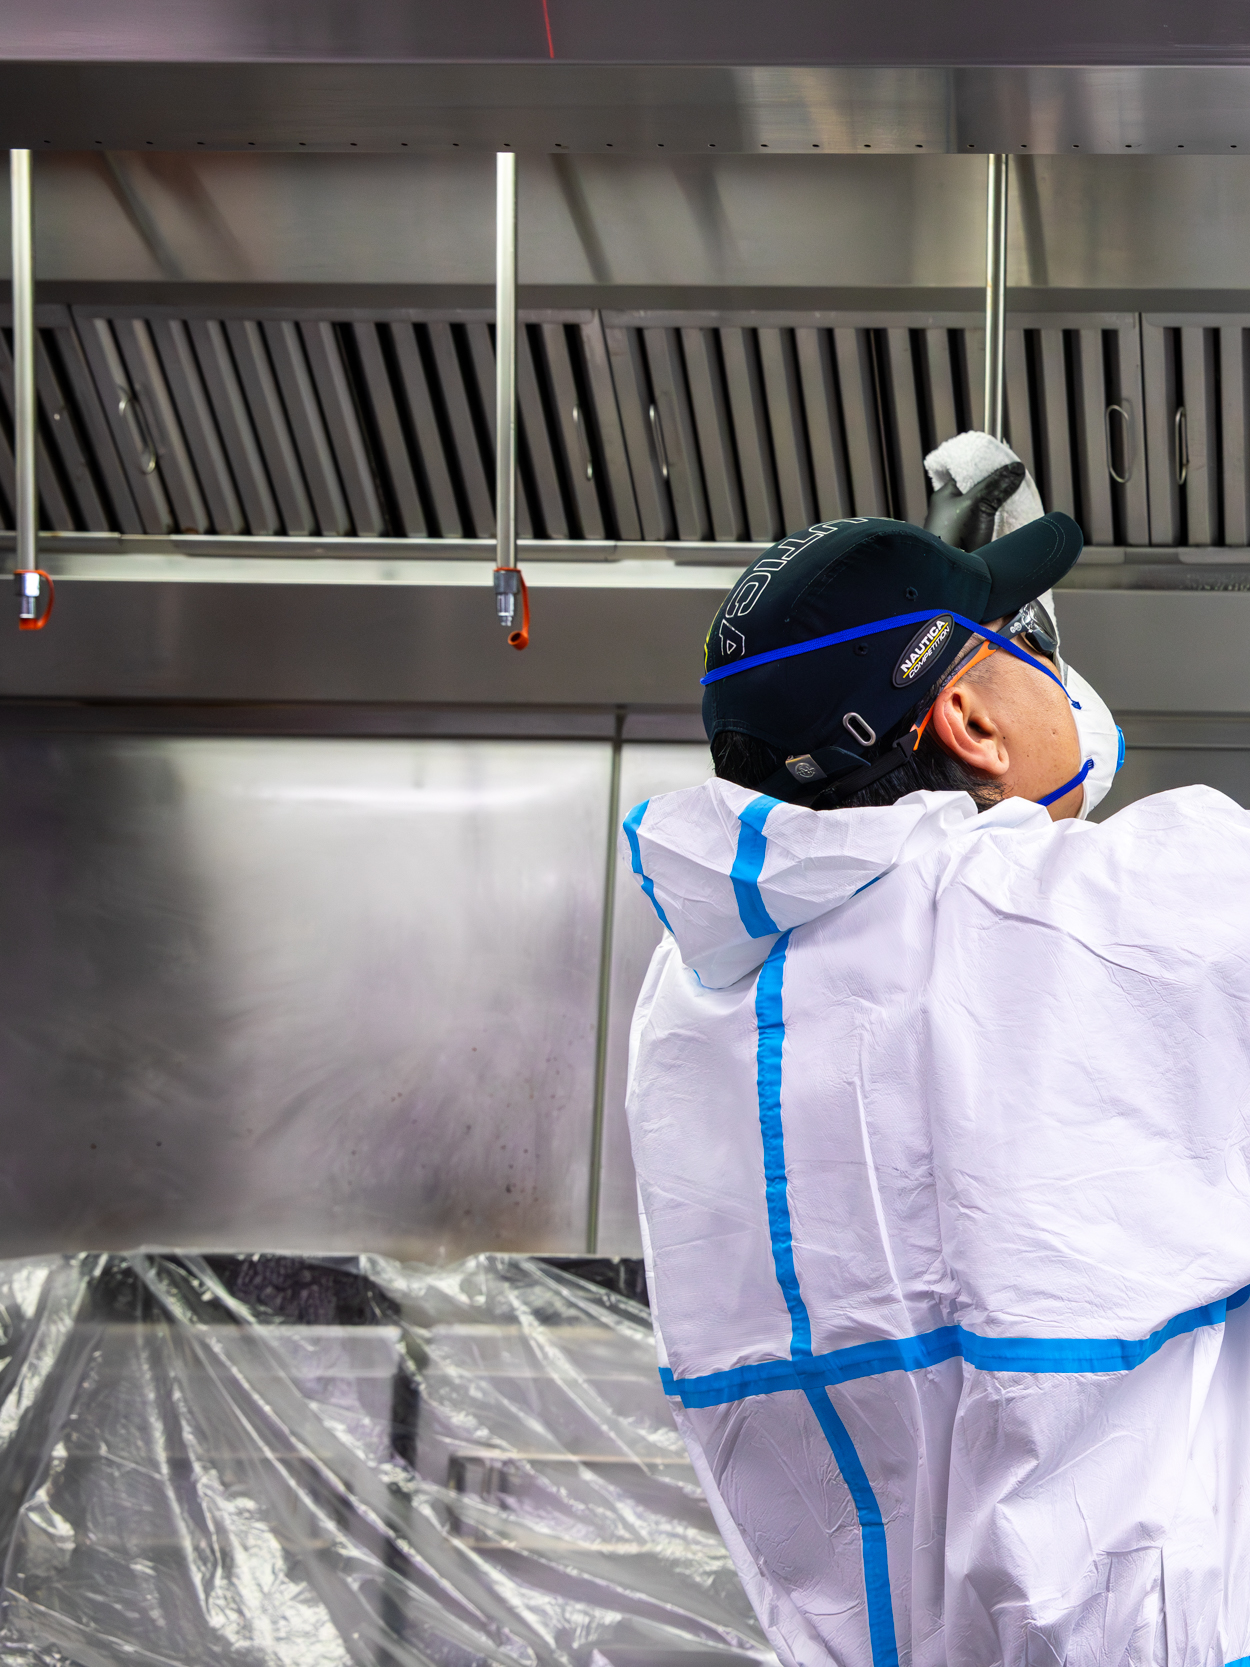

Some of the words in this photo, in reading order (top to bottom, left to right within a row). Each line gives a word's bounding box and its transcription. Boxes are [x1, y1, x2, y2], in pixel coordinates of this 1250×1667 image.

[718, 516, 870, 656] UTICA
[900, 620, 945, 672] NAUTICA
[908, 625, 950, 679] COMPETITION
